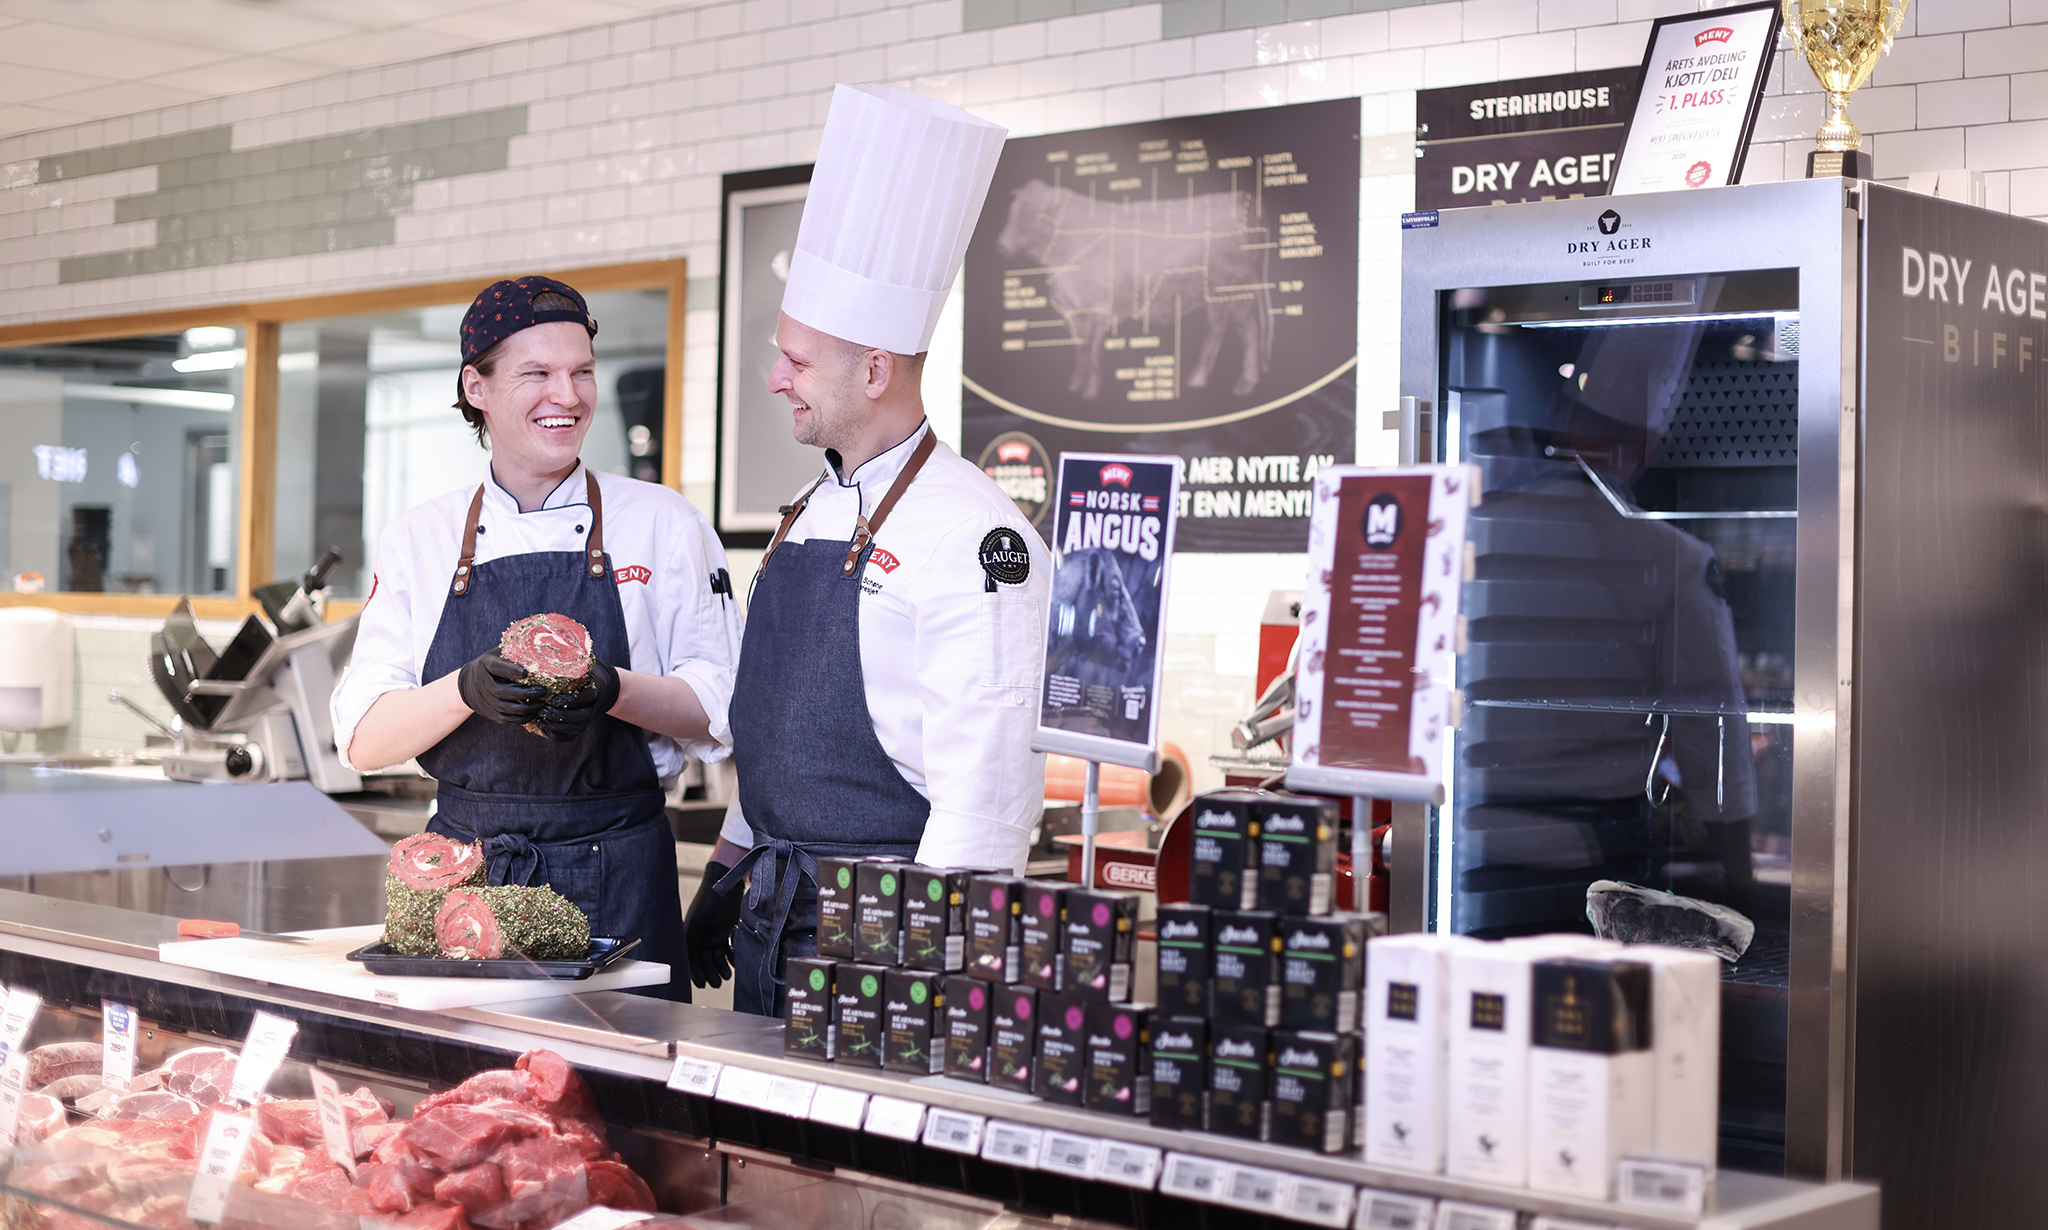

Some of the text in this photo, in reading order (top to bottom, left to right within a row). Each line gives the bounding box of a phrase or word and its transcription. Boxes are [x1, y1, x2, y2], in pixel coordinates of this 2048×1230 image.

[1698, 30, 1731, 43] MENY
[1664, 50, 1747, 72] ÅRETS AVDELING
[1664, 66, 1740, 89] KJØTT/DELI
[1469, 86, 1610, 121] STEAKHOUSE
[1669, 88, 1725, 110] 1. PLASS
[1649, 133, 1667, 144] MENY
[1668, 130, 1698, 143] SANDVIKA
[1451, 160, 1522, 195] DRY
[1567, 237, 1652, 254] DRY AGER
[1902, 246, 2048, 320] DRY AGE
[1944, 323, 2034, 373] BIFF
[1102, 467, 1131, 482] MENY
[1188, 456, 1234, 485] MER
[1236, 455, 1301, 484] NYTTE
[1086, 489, 1142, 512] NORSK
[1193, 490, 1242, 518] ENN
[1243, 489, 1313, 518] MENY!
[1367, 504, 1397, 535] M
[1062, 510, 1162, 563] ANGUS
[868, 551, 898, 569] ENY
[982, 551, 1028, 565] LAUGET
[616, 567, 650, 581] ENY
[1110, 866, 1156, 885] BERKE
[1160, 920, 1199, 939] Jacobs
[1218, 924, 1259, 944] Jacobs
[1287, 930, 1331, 949] Jacobs
[1155, 1031, 1194, 1050] Jacobs
[1216, 1038, 1256, 1057] Jacobs
[1278, 1047, 1320, 1067] Jacobs
